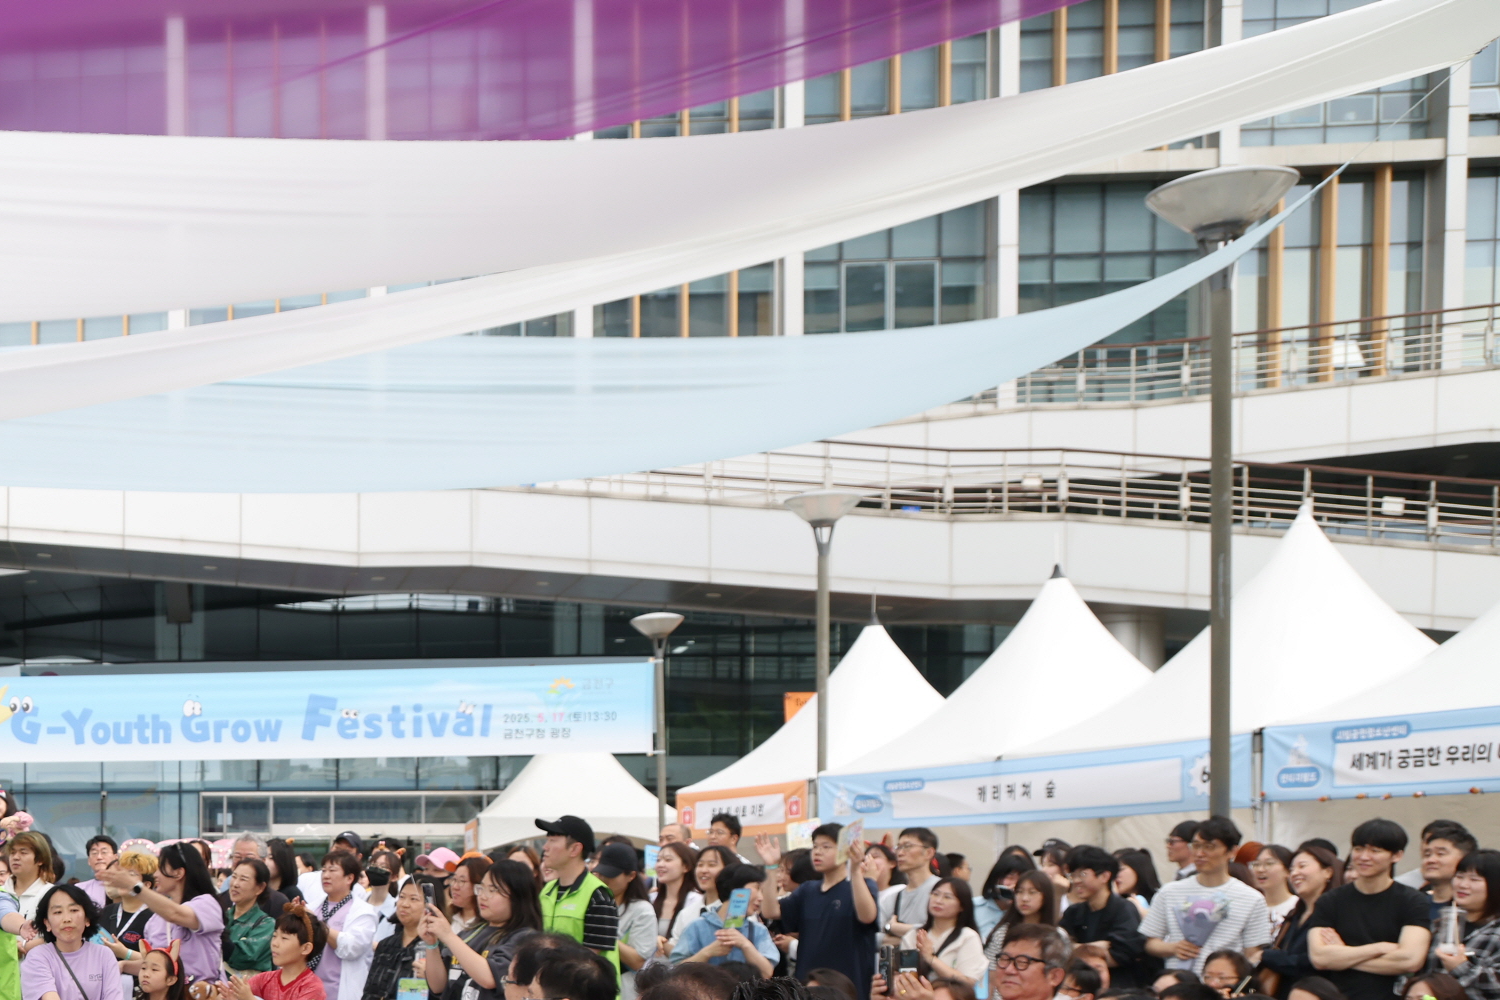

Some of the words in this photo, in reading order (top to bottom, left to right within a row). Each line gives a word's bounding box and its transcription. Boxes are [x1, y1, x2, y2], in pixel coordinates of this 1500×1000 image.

[10, 704, 173, 746] G-Youth
[180, 714, 283, 744] Grow
[301, 693, 493, 742] Festival
[550, 727, 572, 739] 광장
[1350, 750, 1393, 771] 세계가
[1397, 746, 1441, 769] 궁금한
[1445, 742, 1493, 764] 우리의
